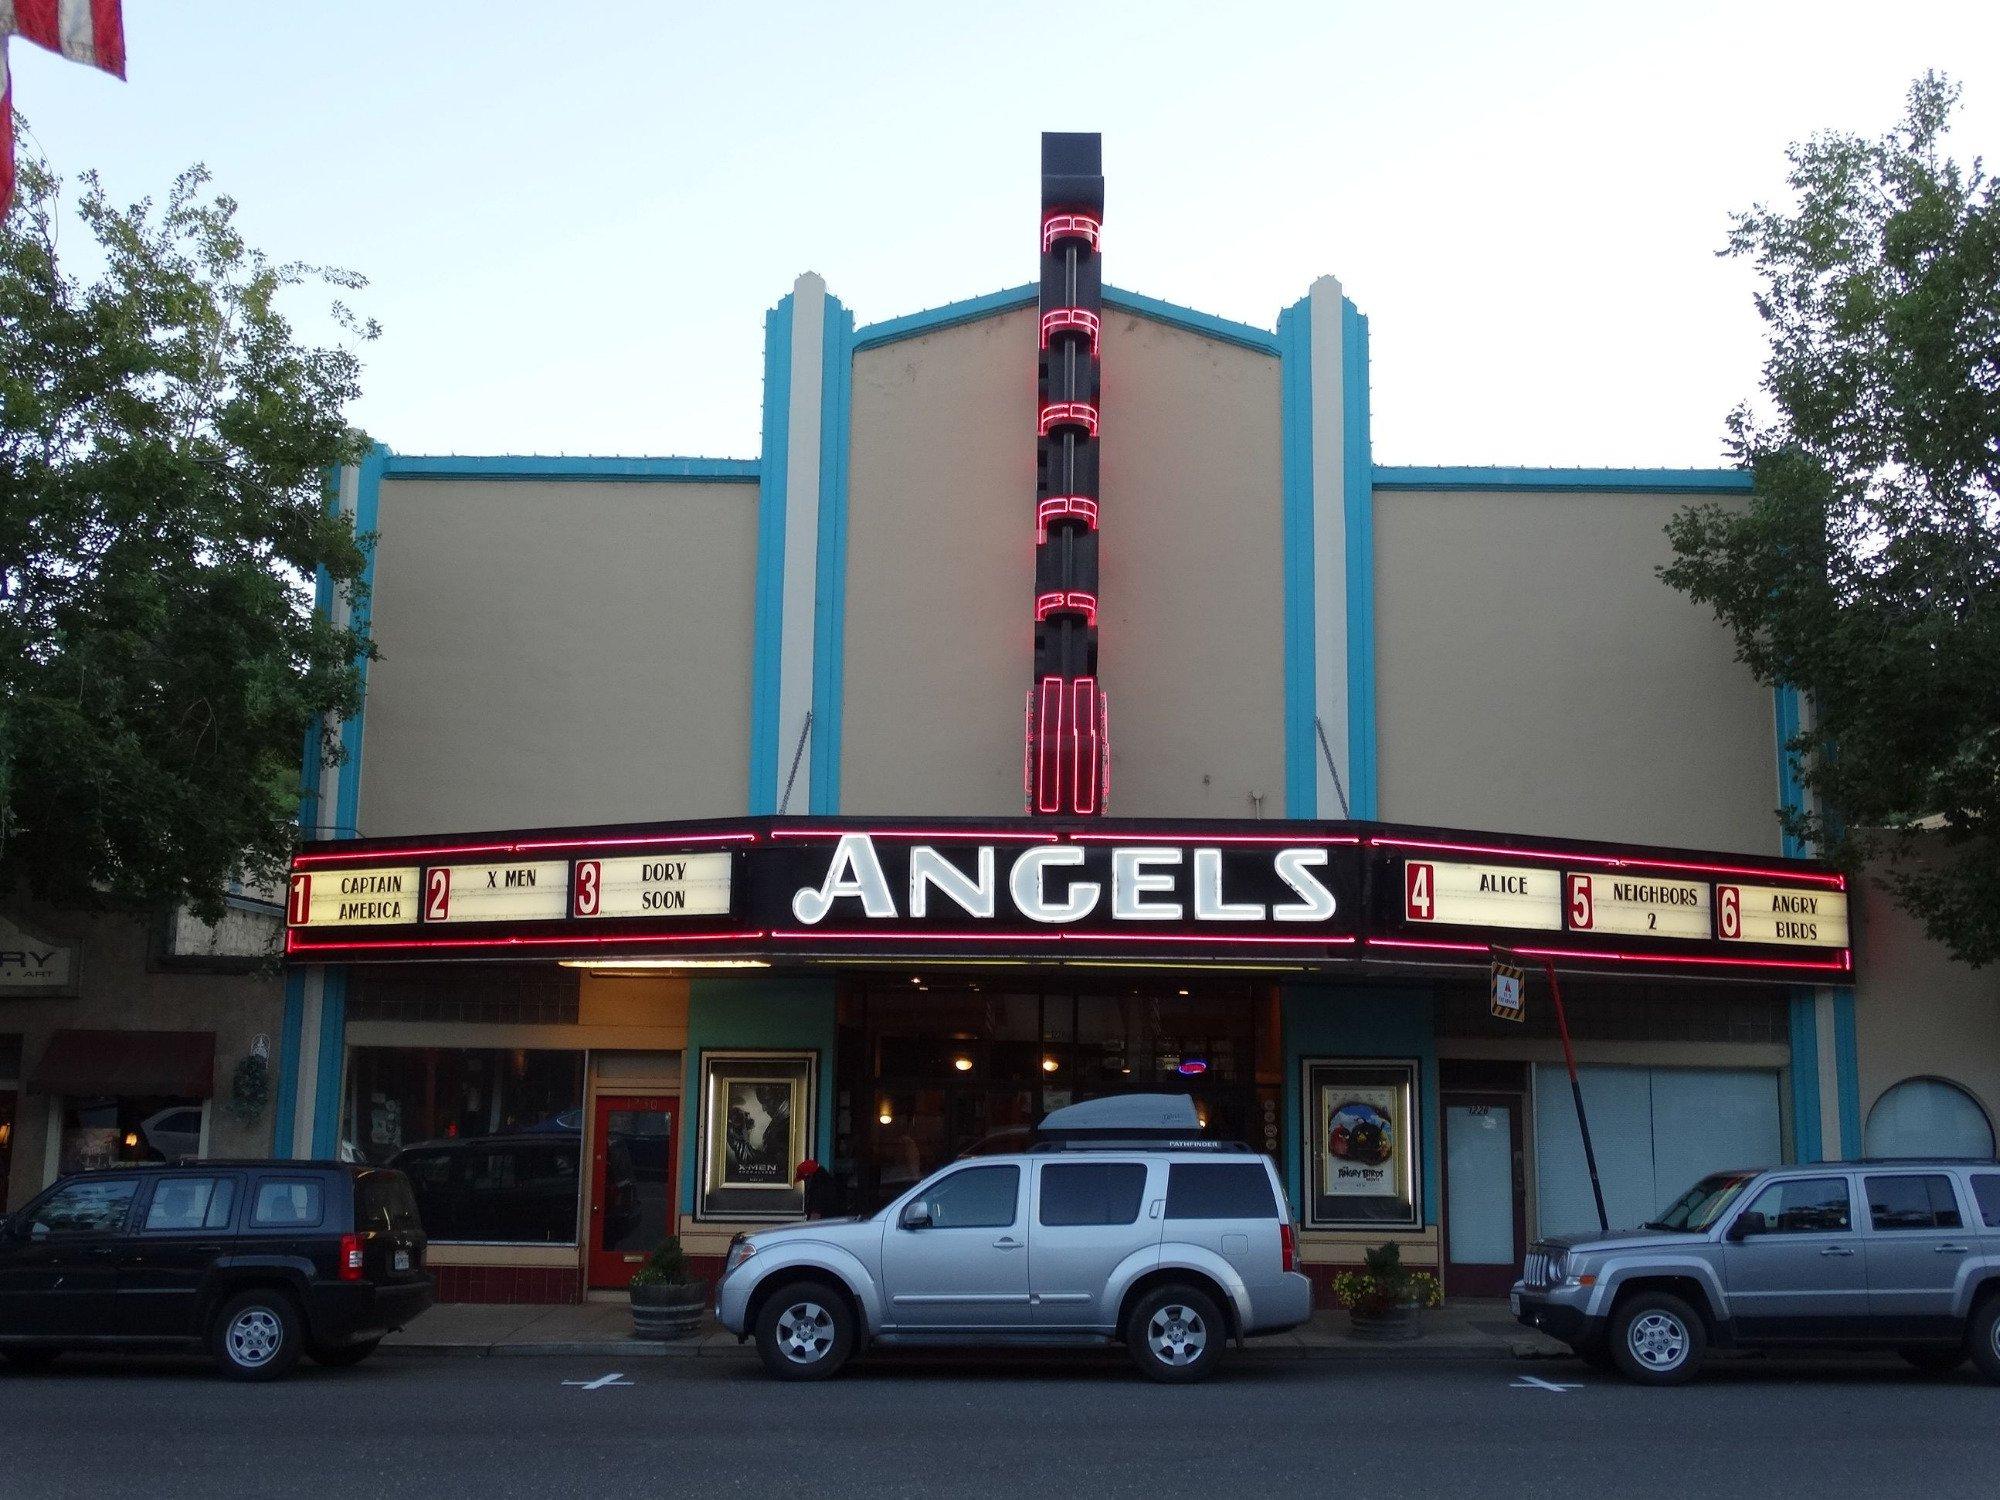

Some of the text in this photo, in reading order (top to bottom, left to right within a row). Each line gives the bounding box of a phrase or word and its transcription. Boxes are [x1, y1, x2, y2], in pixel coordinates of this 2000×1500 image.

[486, 868, 537, 889] X MEN
[641, 862, 687, 882] DORY
[792, 833, 1338, 925] ANGELS
[341, 875, 402, 894] CAPTAIN
[429, 870, 447, 918] 2
[579, 862, 598, 914] 3
[1412, 866, 1430, 918] 4
[1479, 873, 1529, 895] ALICE
[1613, 883, 1698, 906] NEIGHBORS
[293, 877, 305, 922] 1
[338, 901, 402, 920] AMERICA
[641, 891, 686, 910] SOON
[1572, 876, 1590, 927] 5
[1772, 894, 1818, 915] ANGRY
[1647, 912, 1658, 931] 2
[1721, 888, 1737, 937] 6
[1775, 921, 1818, 941] BIRDS
